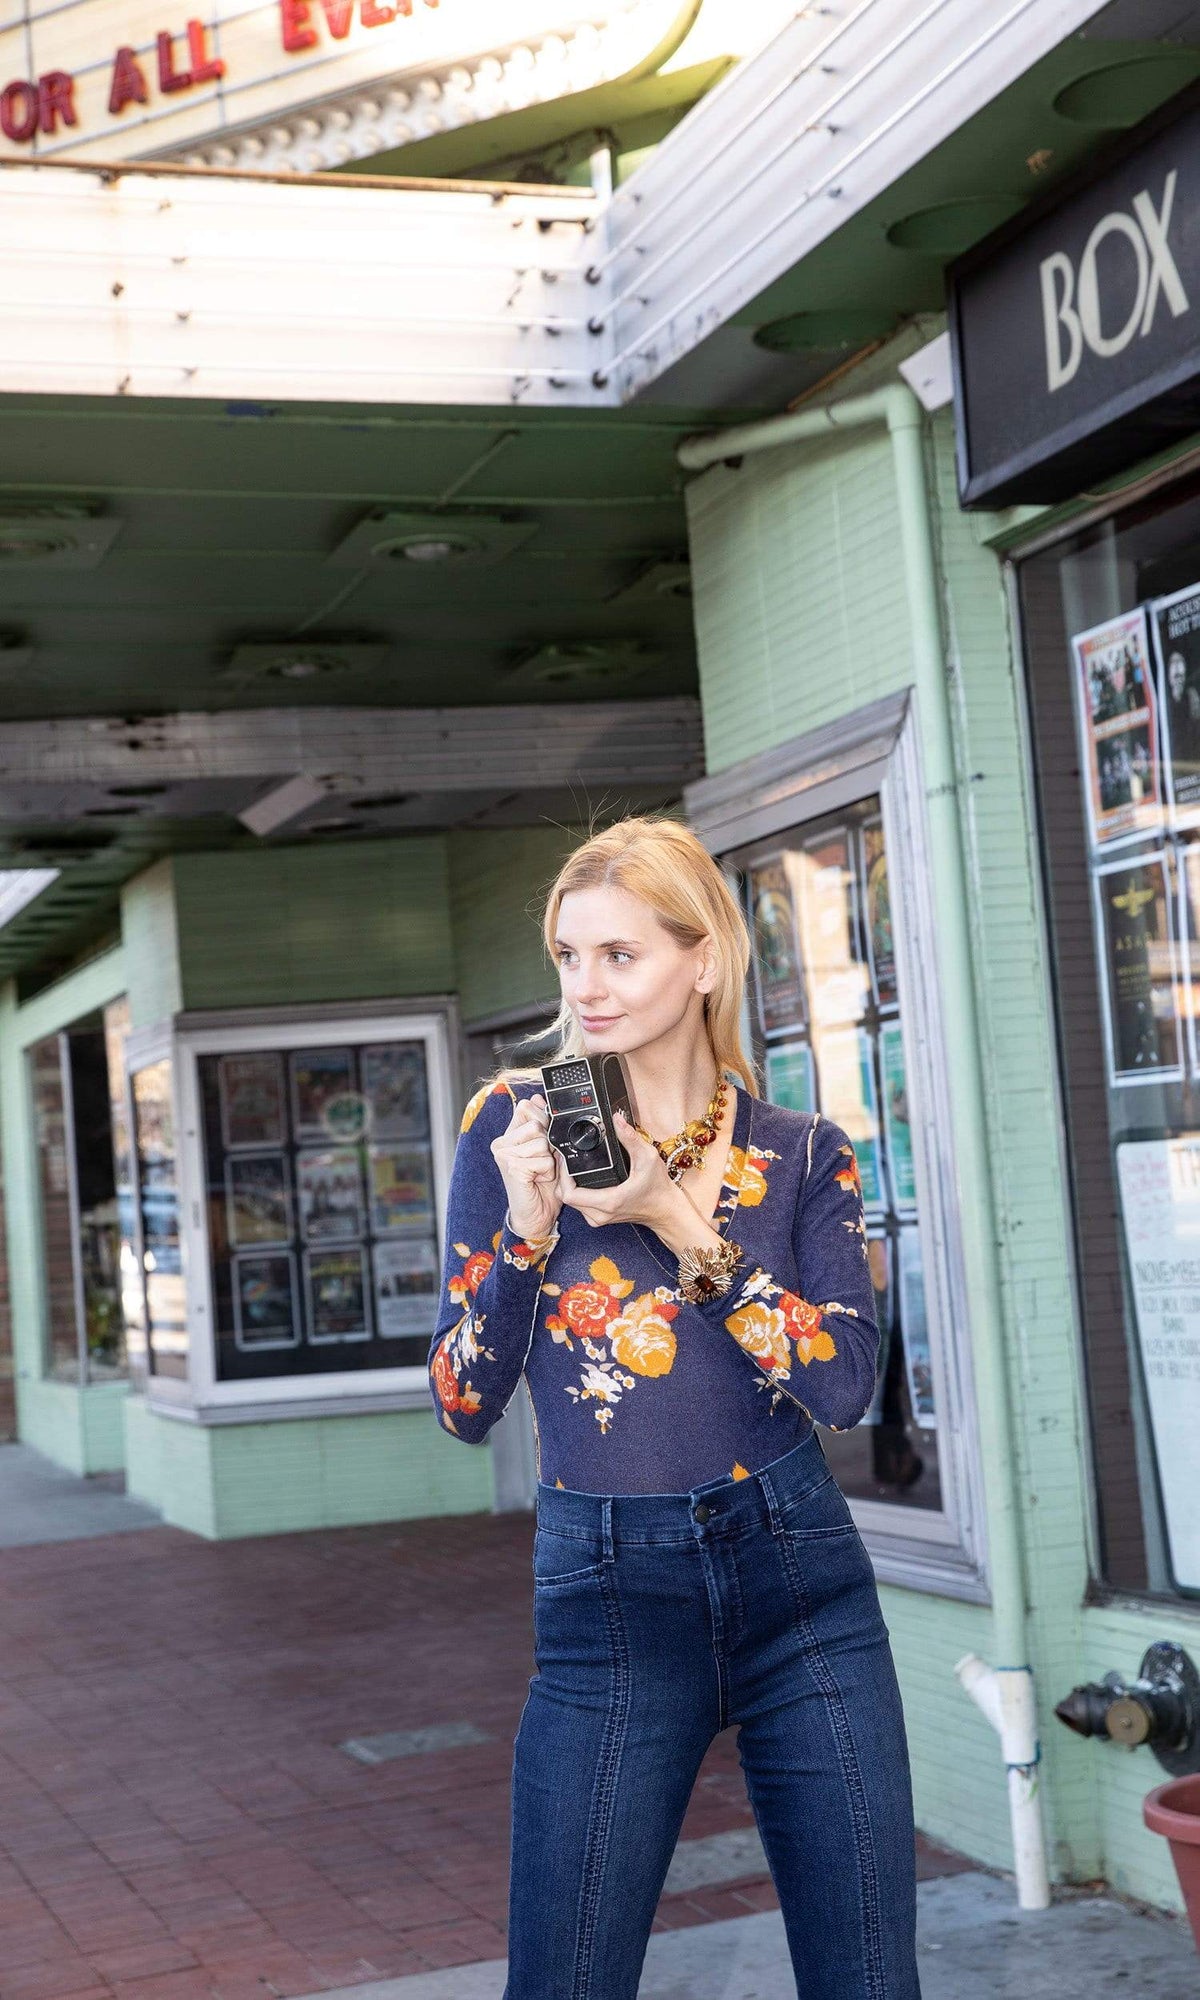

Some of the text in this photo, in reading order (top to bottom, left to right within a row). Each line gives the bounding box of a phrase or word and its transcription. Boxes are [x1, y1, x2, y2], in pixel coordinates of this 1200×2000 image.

[107, 18, 226, 115] ALL
[280, 0, 440, 53] EVE
[1039, 168, 1190, 394] BOX
